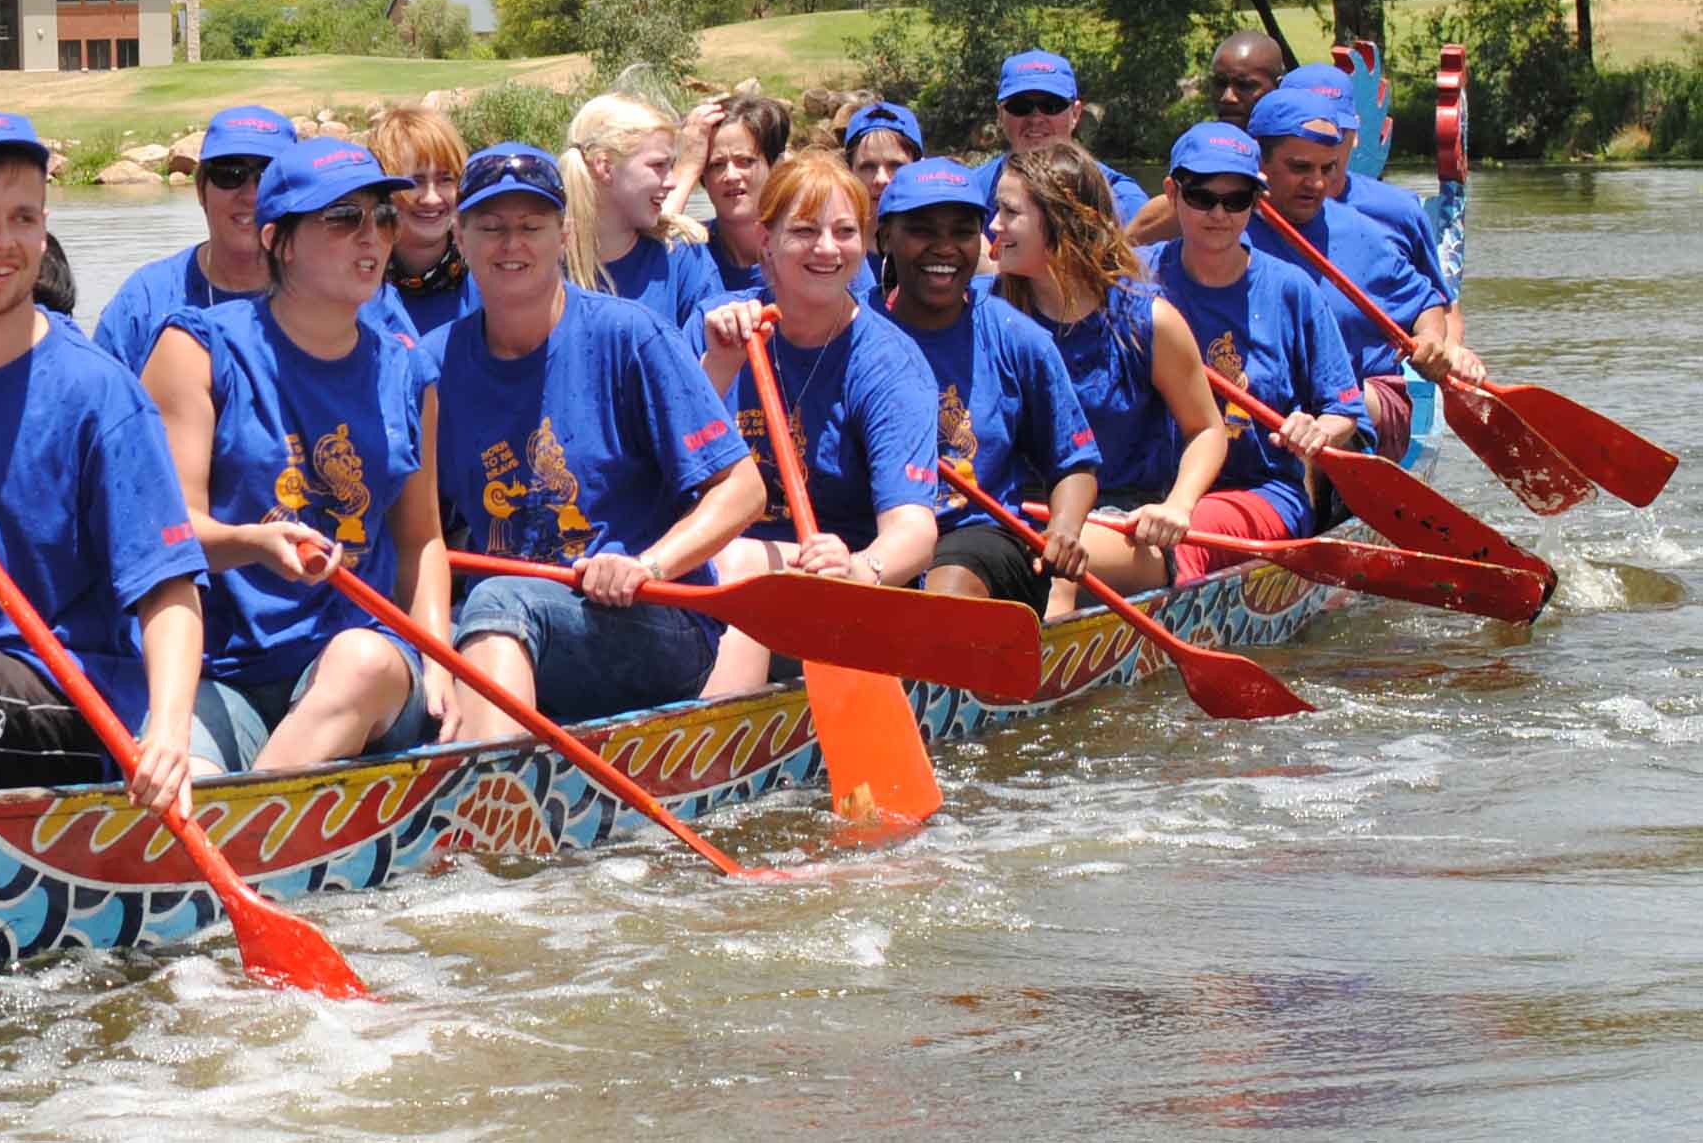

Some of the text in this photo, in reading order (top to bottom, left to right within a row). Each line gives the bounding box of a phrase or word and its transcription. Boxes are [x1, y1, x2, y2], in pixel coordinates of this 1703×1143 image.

[480, 440, 509, 459] BORN
[482, 449, 514, 469] TO BE
[485, 458, 520, 481] BRAVE
